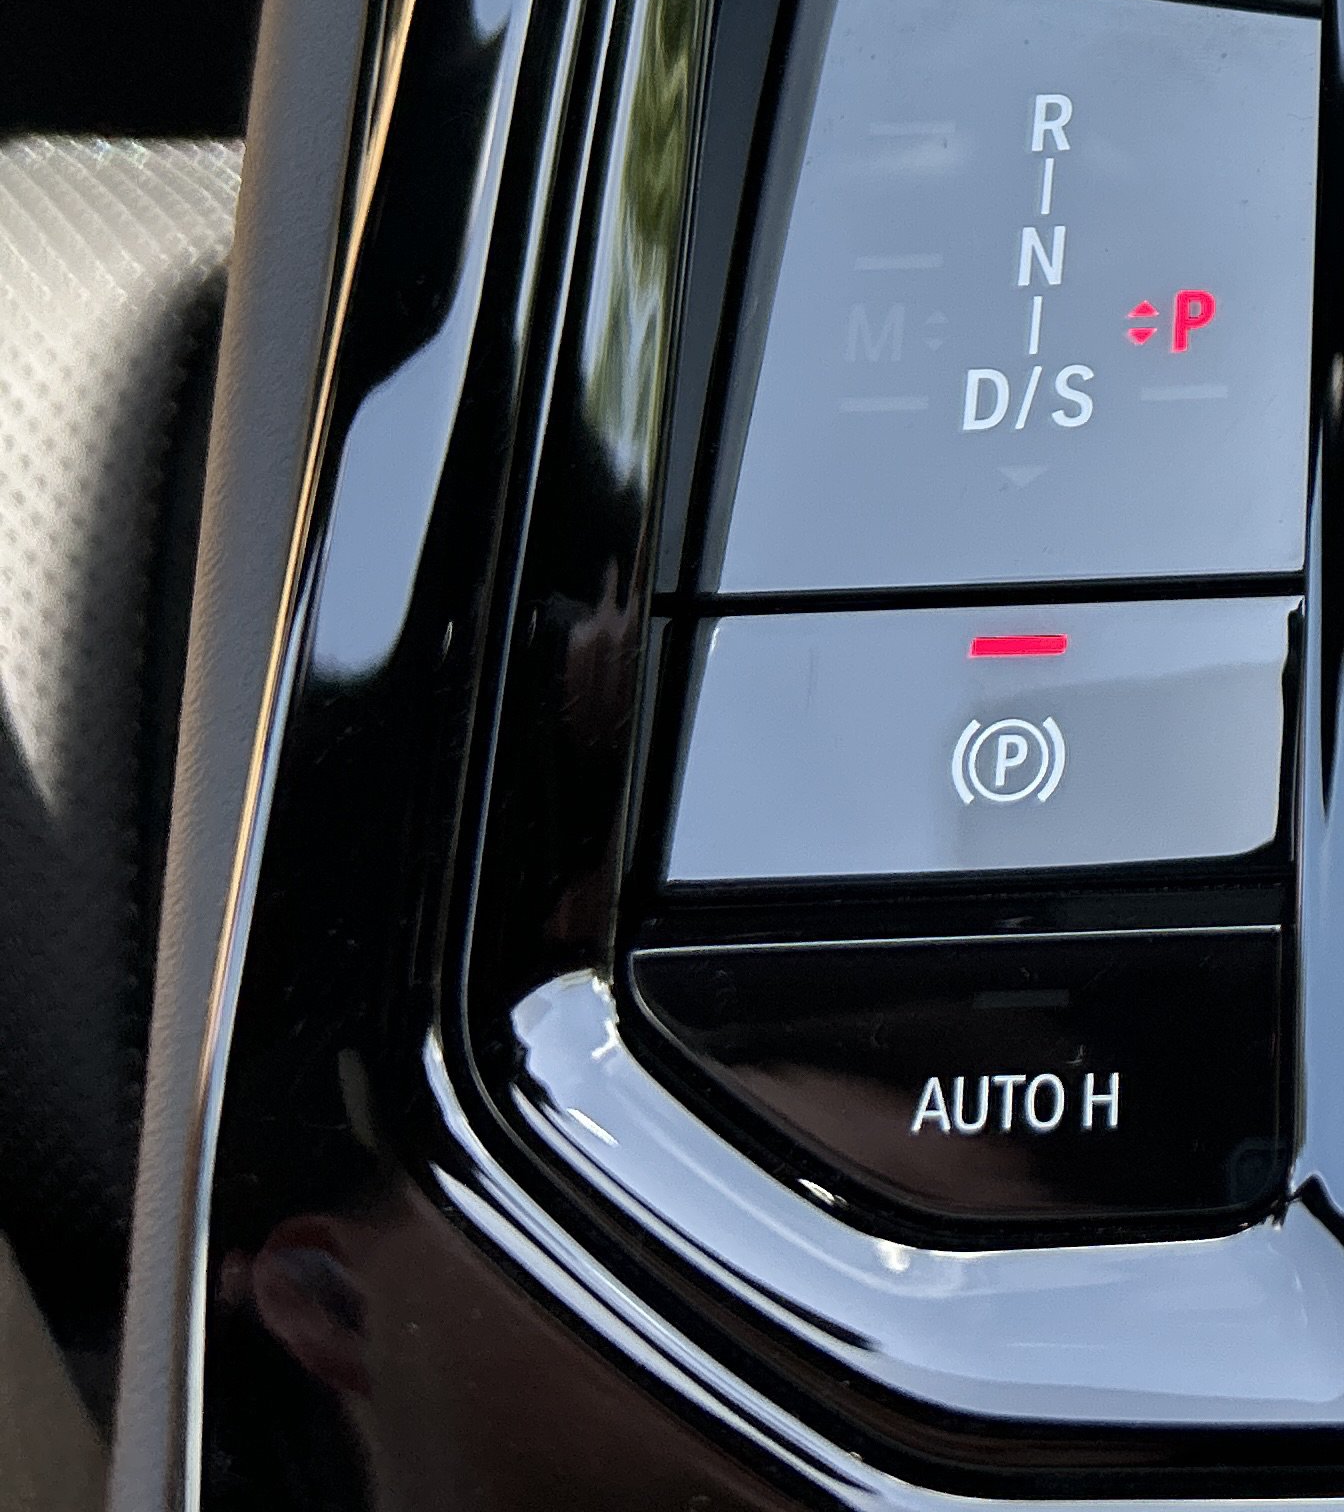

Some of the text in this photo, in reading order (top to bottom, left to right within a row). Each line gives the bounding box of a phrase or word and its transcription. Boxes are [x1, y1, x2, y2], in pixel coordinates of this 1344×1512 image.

[1031, 93, 1073, 152] R
[1017, 225, 1066, 287] N
[844, 303, 906, 364] M
[1171, 289, 1217, 354] P
[962, 364, 1094, 431] D/S
[911, 1071, 1121, 1135] AUTO H
